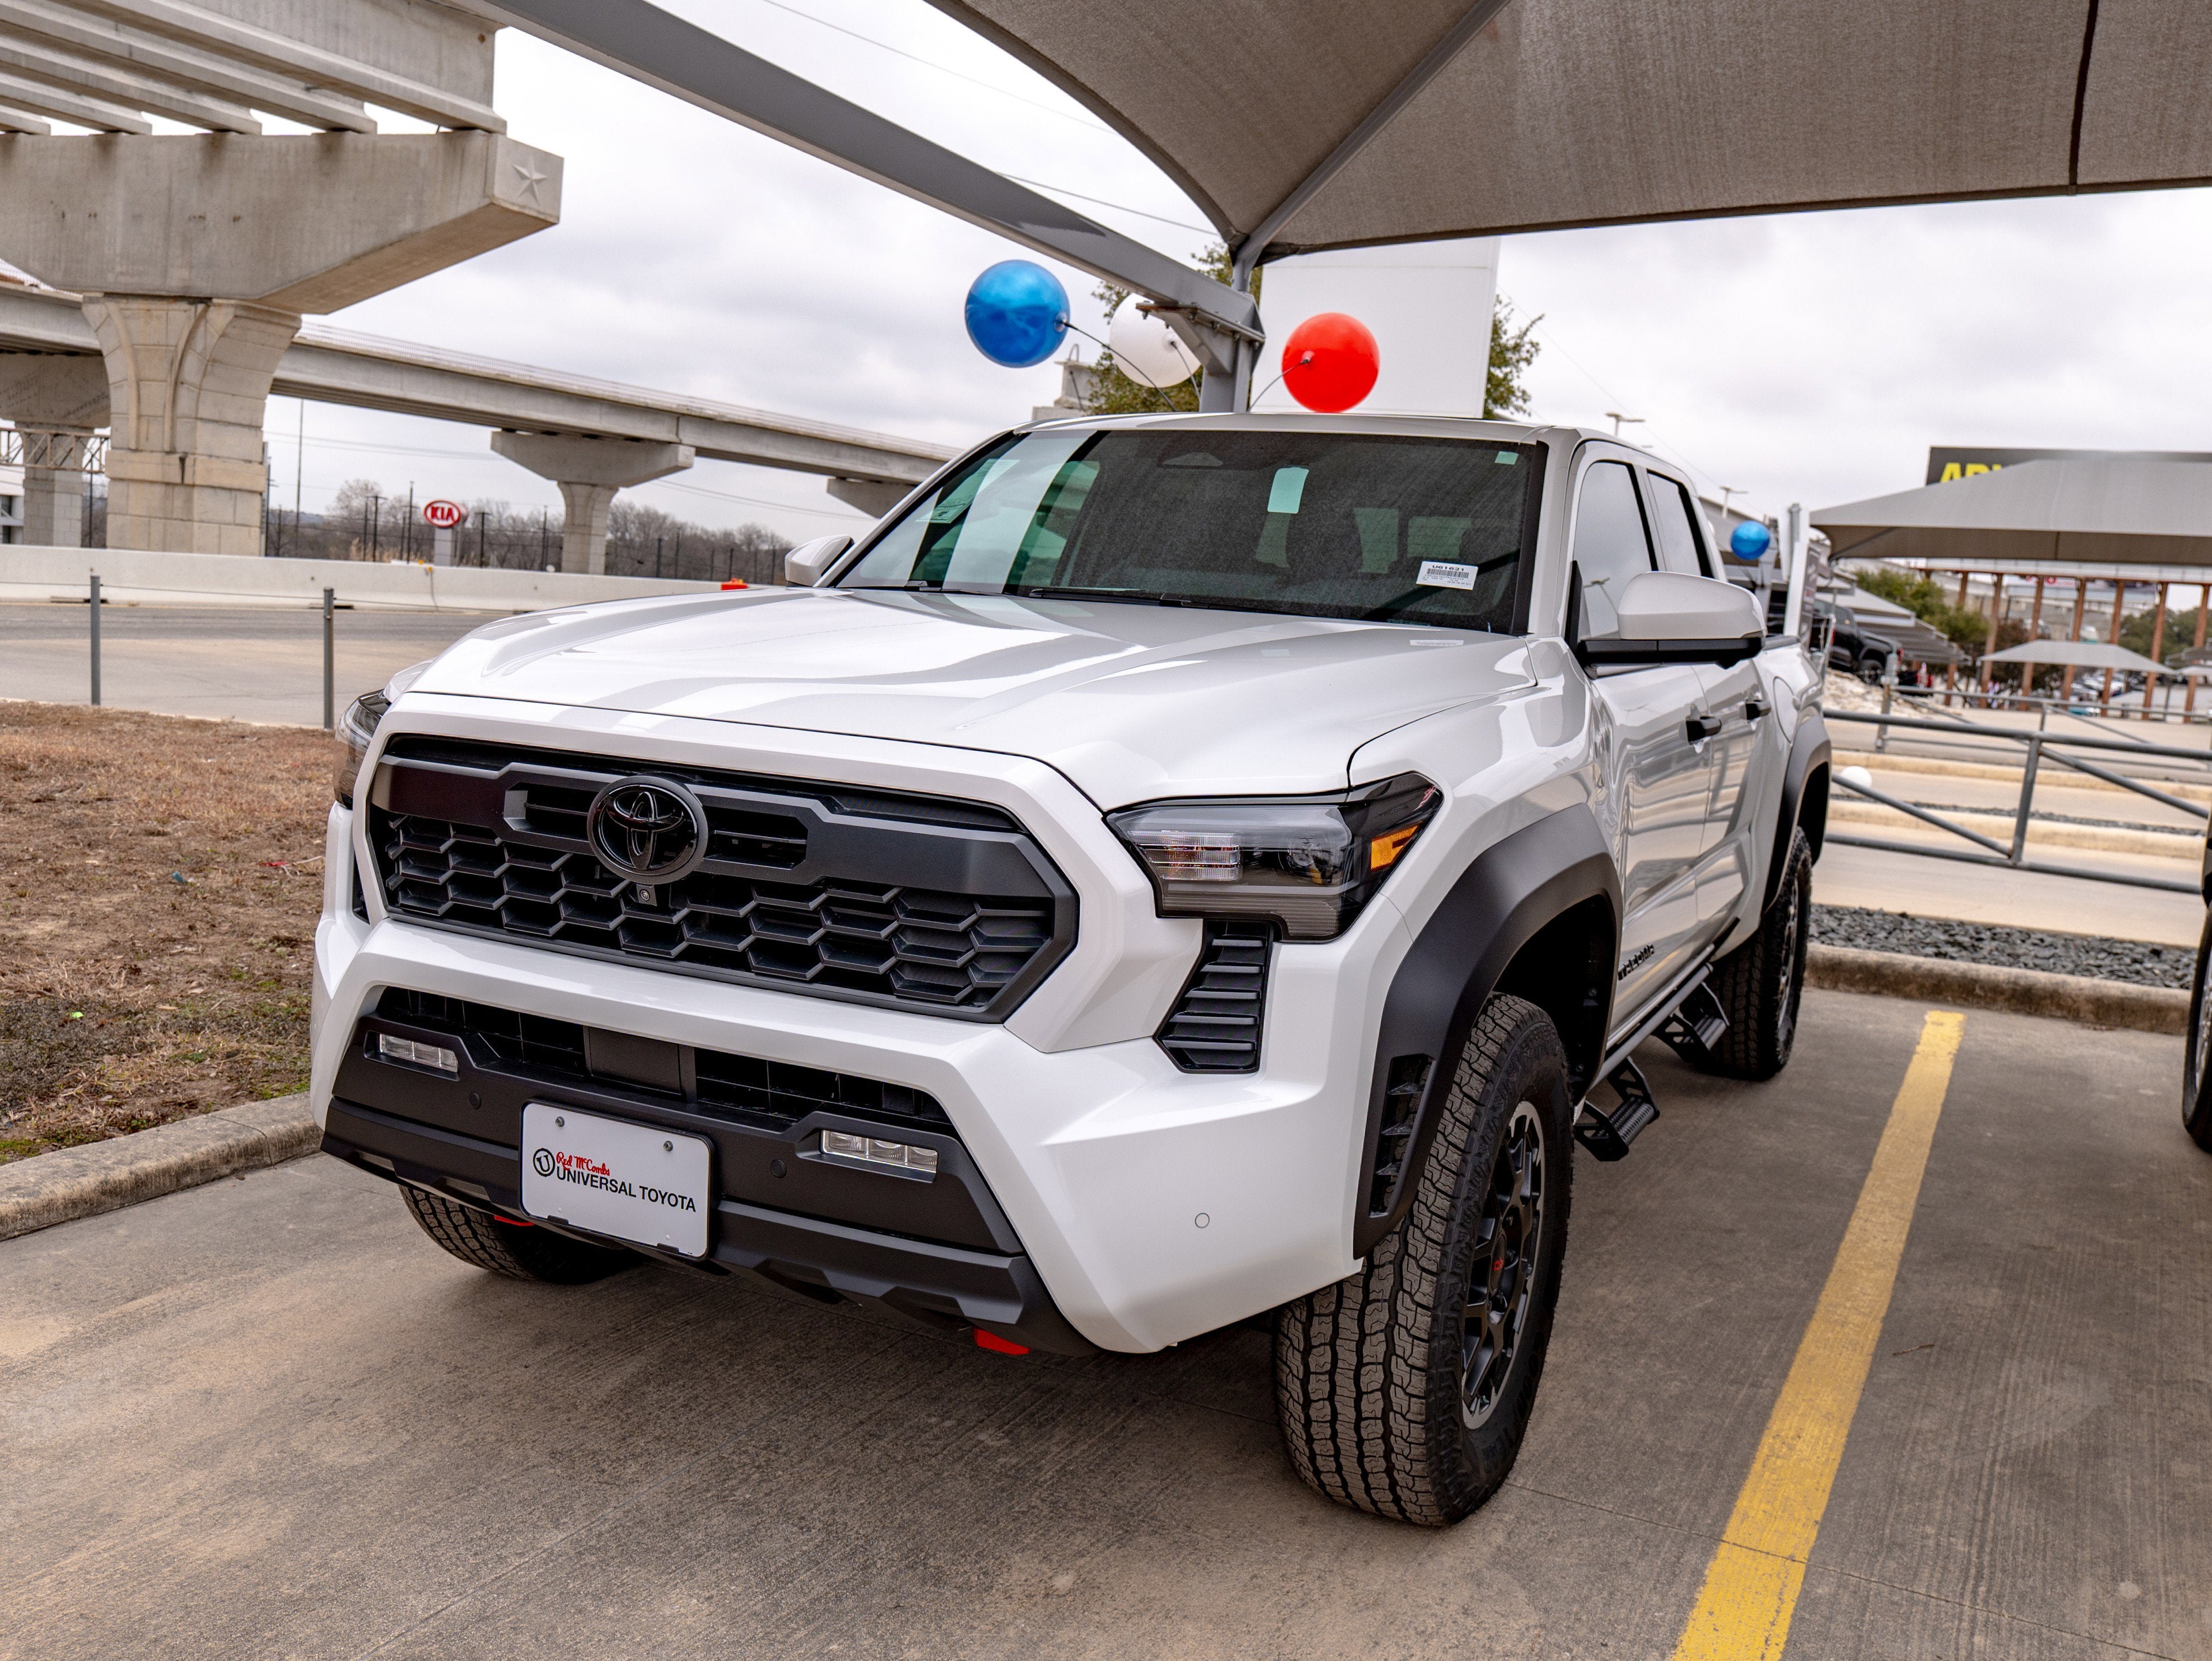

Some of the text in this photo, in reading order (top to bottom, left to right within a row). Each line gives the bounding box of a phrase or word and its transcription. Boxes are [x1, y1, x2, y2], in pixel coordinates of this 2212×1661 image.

[430, 506, 455, 522] KIA
[1377, 805, 1409, 818] TACOMA
[556, 1152, 610, 1176] Red McCombs
[556, 1166, 696, 1212] UNIVERSAL TOYOTA
